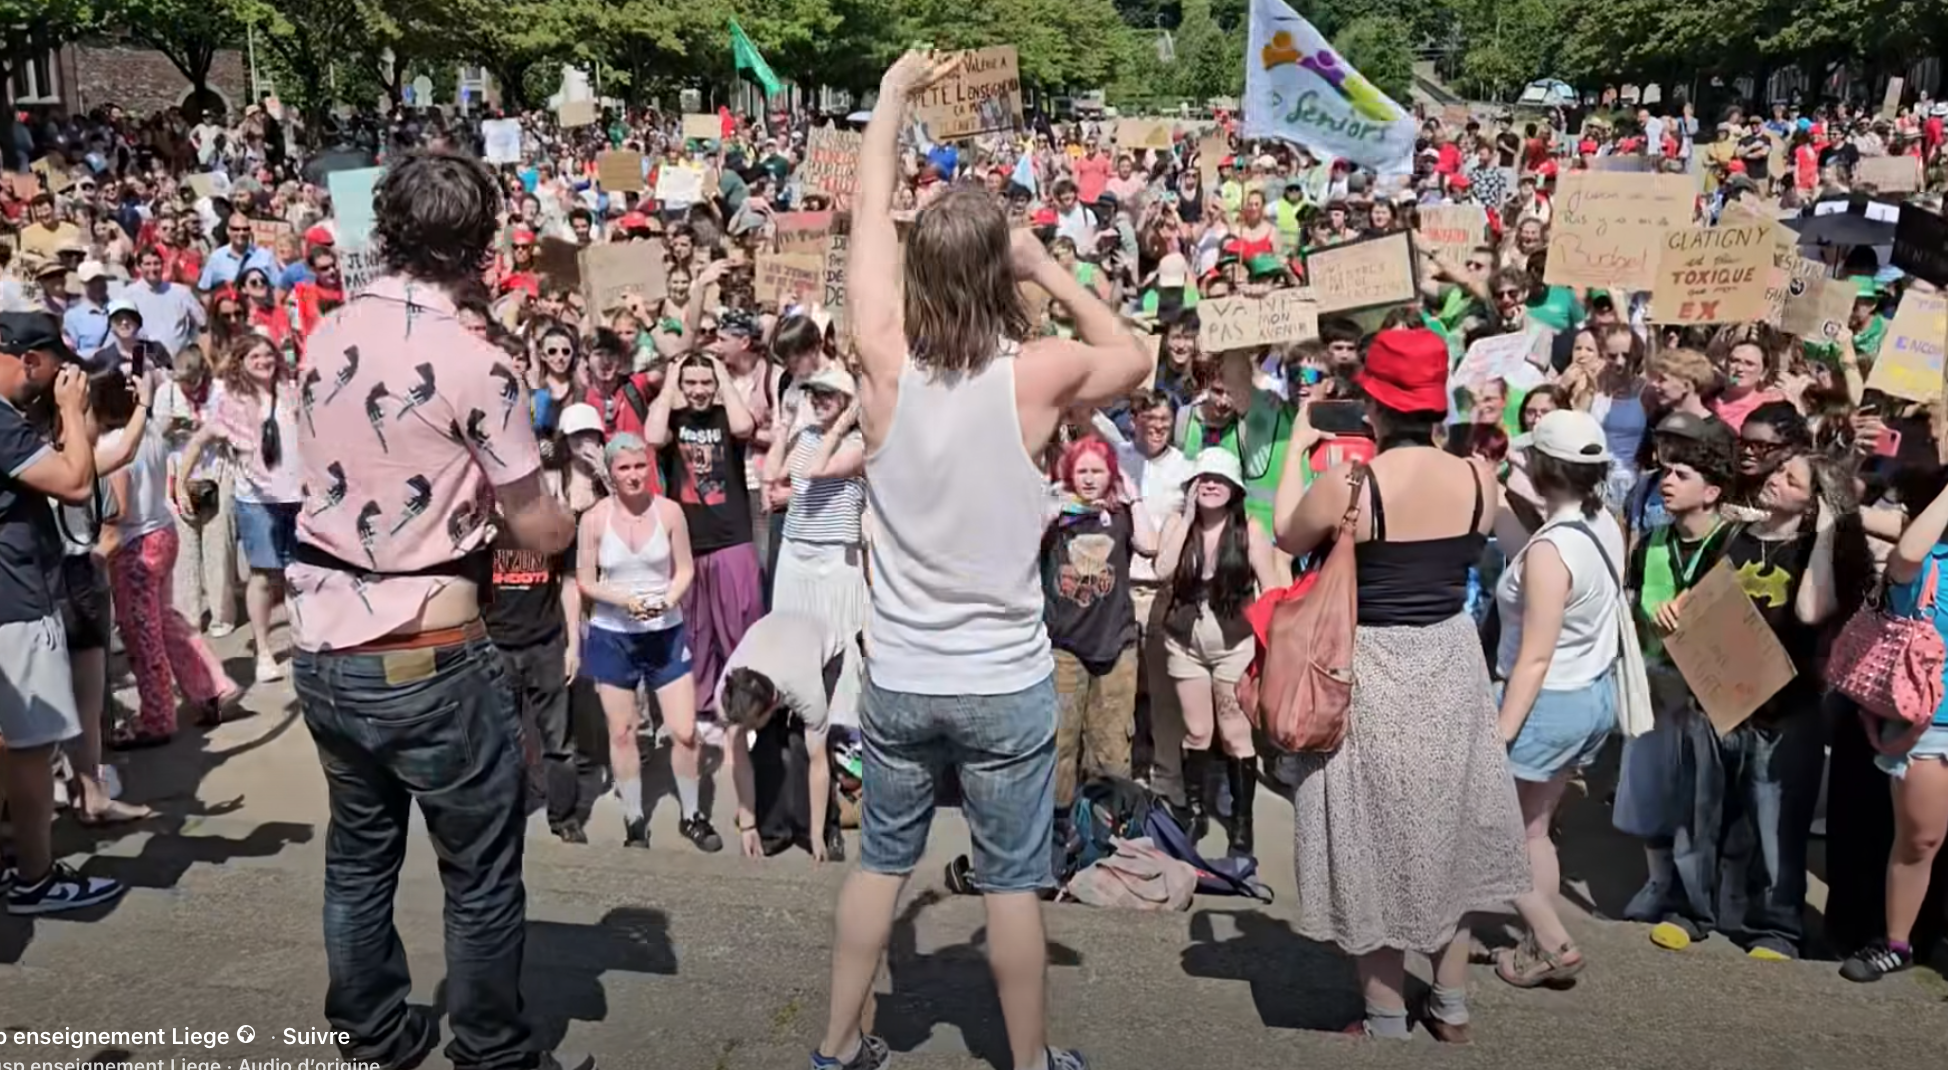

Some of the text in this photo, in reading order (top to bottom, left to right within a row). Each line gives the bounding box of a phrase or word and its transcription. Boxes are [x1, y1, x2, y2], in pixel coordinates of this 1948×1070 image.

[1668, 226, 1770, 251] GLATIGNY
[1672, 267, 1756, 285] TOXIQUE
[1678, 300, 1720, 320] EX
